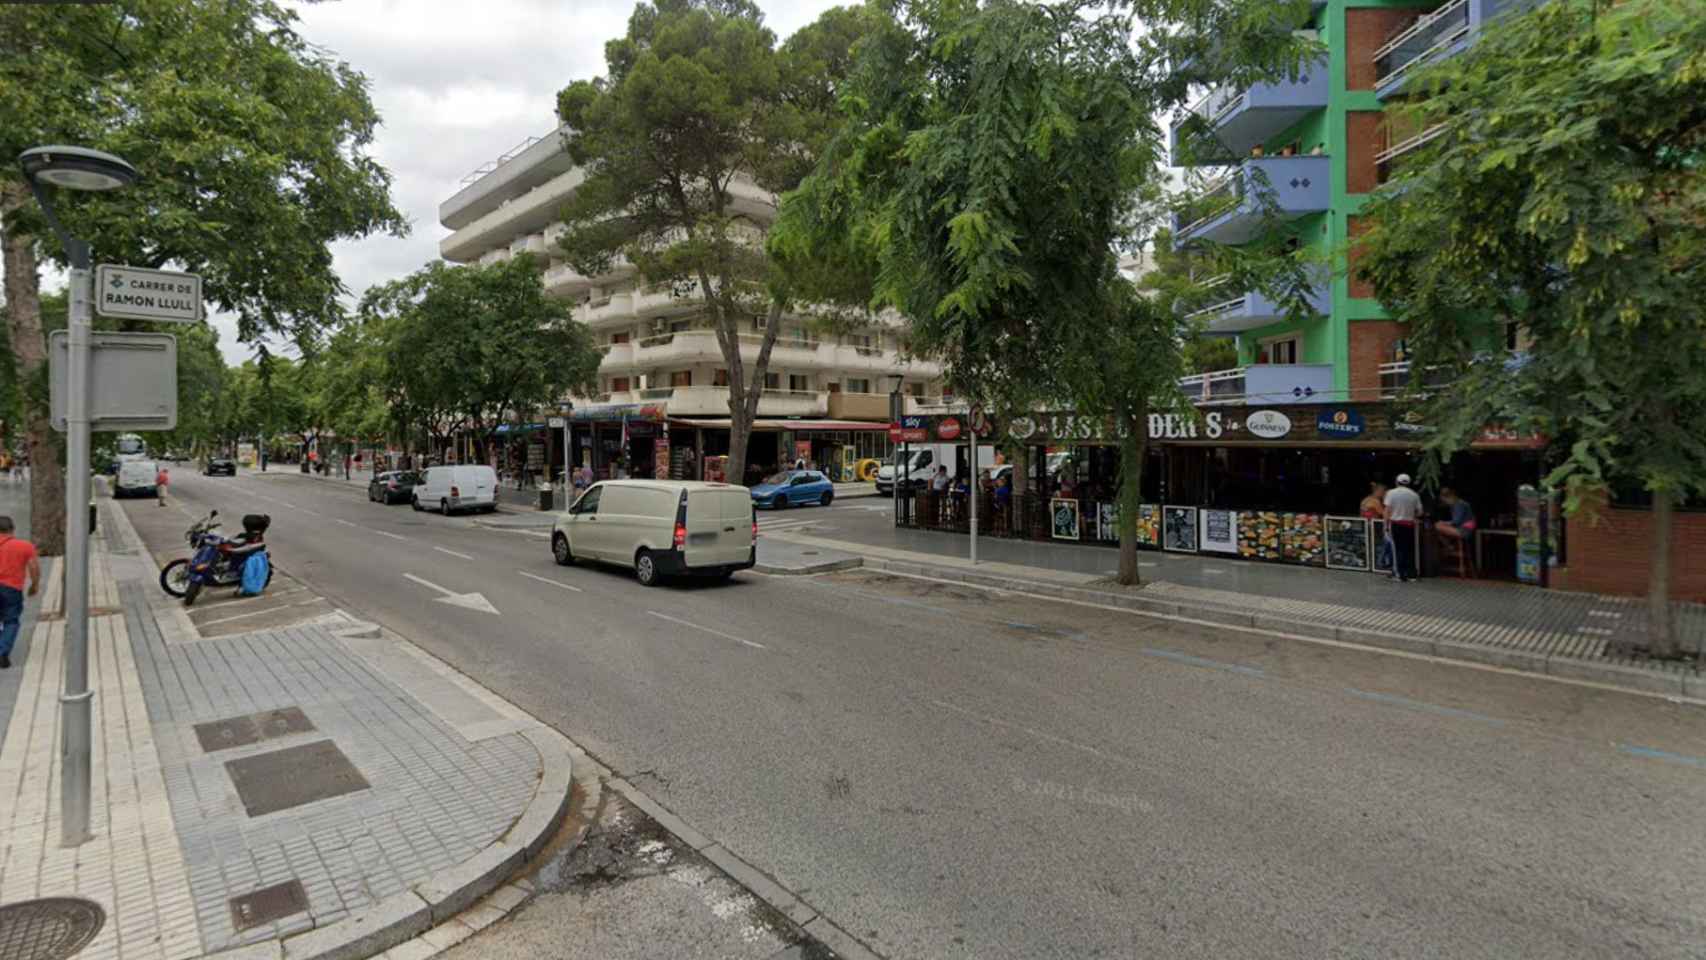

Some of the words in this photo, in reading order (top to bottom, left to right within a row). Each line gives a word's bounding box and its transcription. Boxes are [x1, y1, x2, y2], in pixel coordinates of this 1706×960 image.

[130, 280, 175, 292] CARRER
[177, 284, 193, 294] DE
[106, 293, 154, 307] RAMON
[158, 297, 193, 310] LLULL
[904, 416, 921, 428] sky
